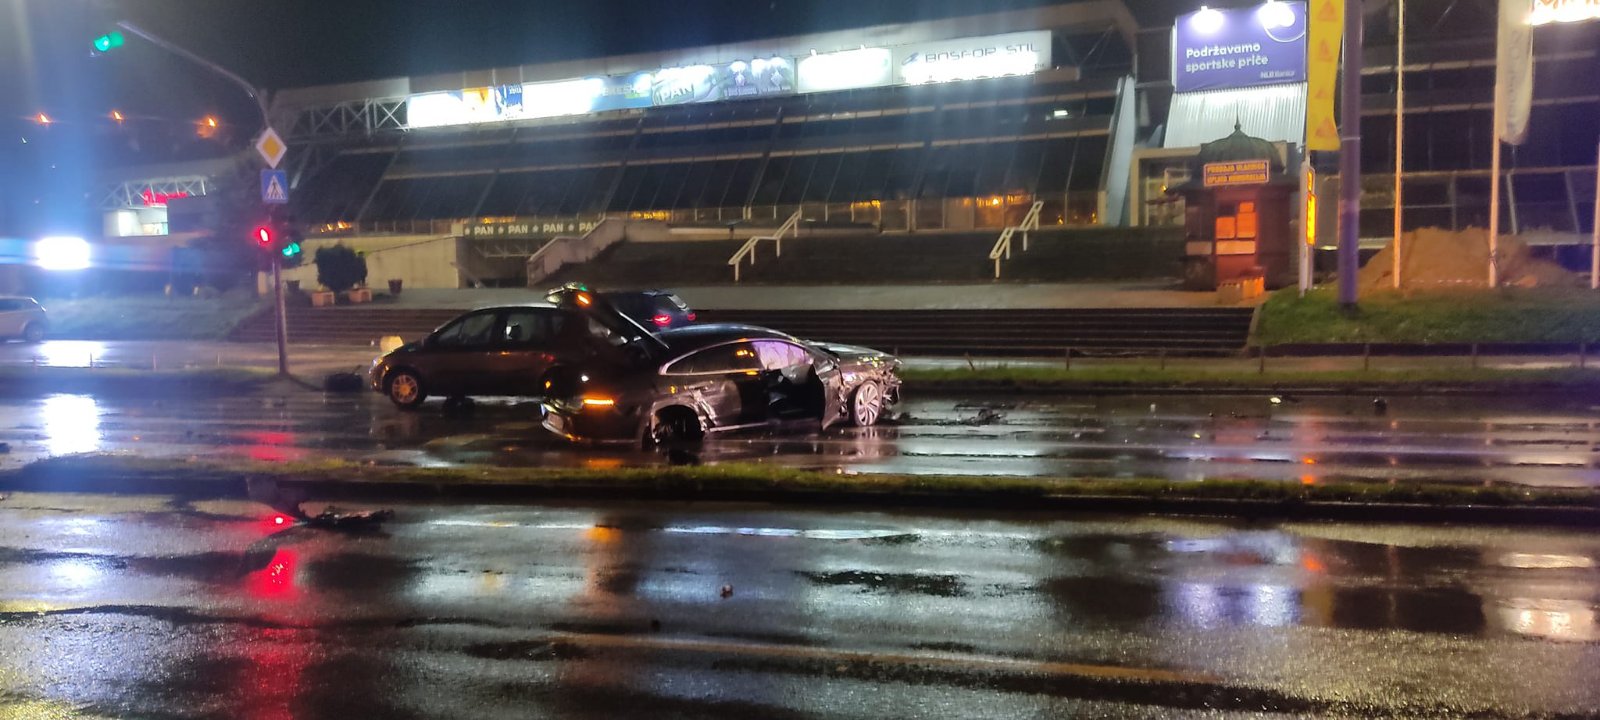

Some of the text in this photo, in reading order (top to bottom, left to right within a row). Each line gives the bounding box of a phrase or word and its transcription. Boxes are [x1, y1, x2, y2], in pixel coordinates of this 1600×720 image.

[1006, 43, 1041, 54] STIL
[1186, 43, 1261, 59] Podržavamo
[1185, 55, 1269, 73] sportske priče
[474, 226, 494, 235] PAN
[508, 225, 528, 234] PAN
[543, 223, 563, 233] PAN
